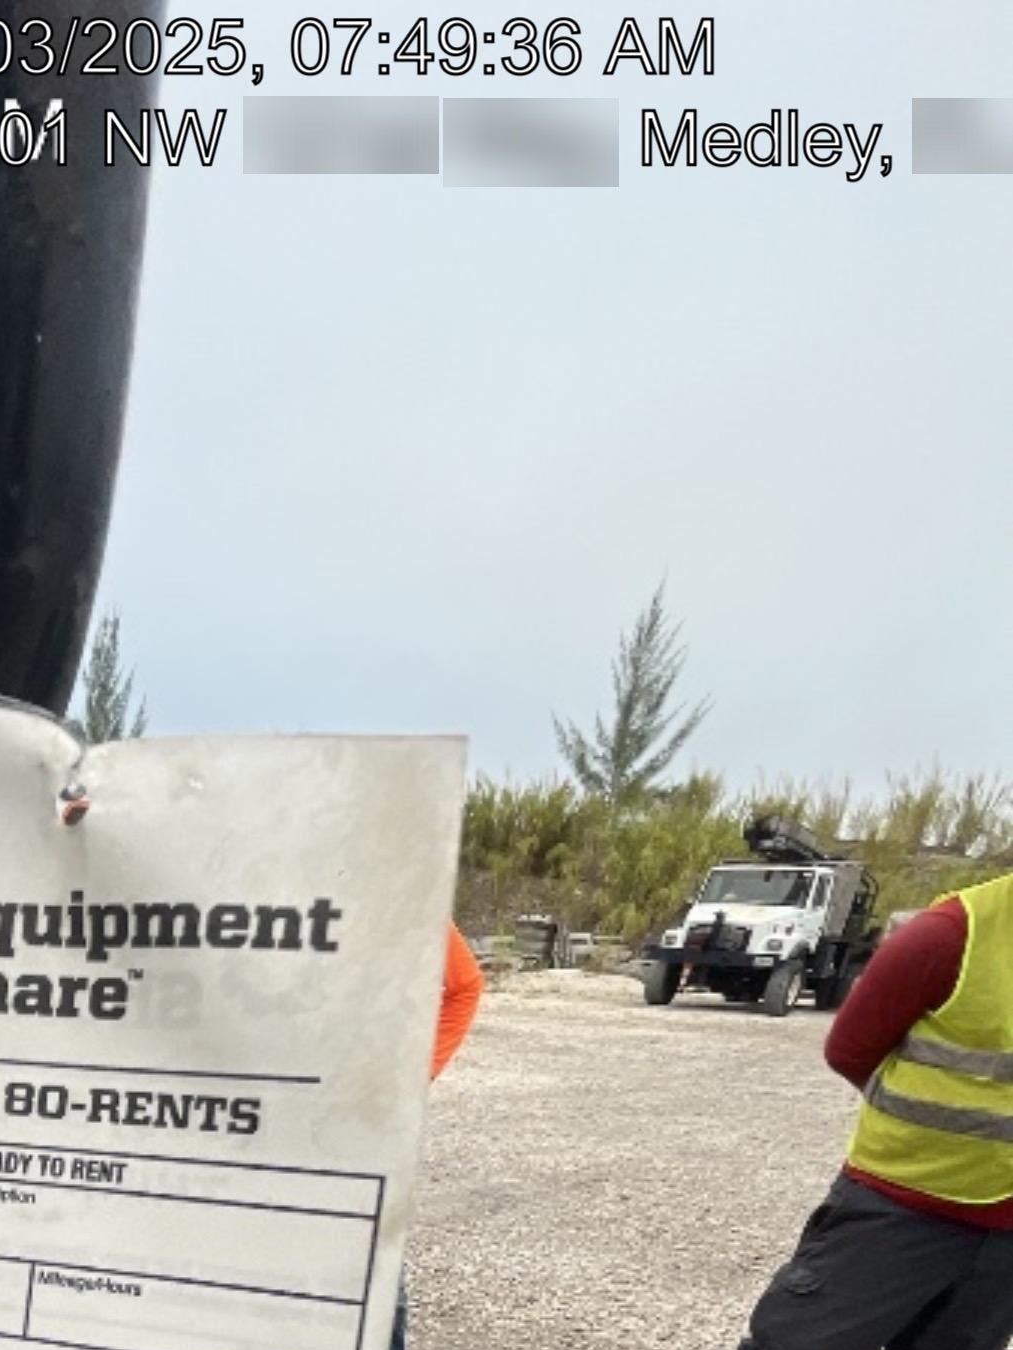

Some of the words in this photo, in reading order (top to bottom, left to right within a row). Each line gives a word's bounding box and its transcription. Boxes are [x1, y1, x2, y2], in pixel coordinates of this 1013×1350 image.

[4, 1082, 262, 1136] 80-RENTS
[37, 1154, 66, 1177] TO
[70, 1158, 129, 1184] RENT
